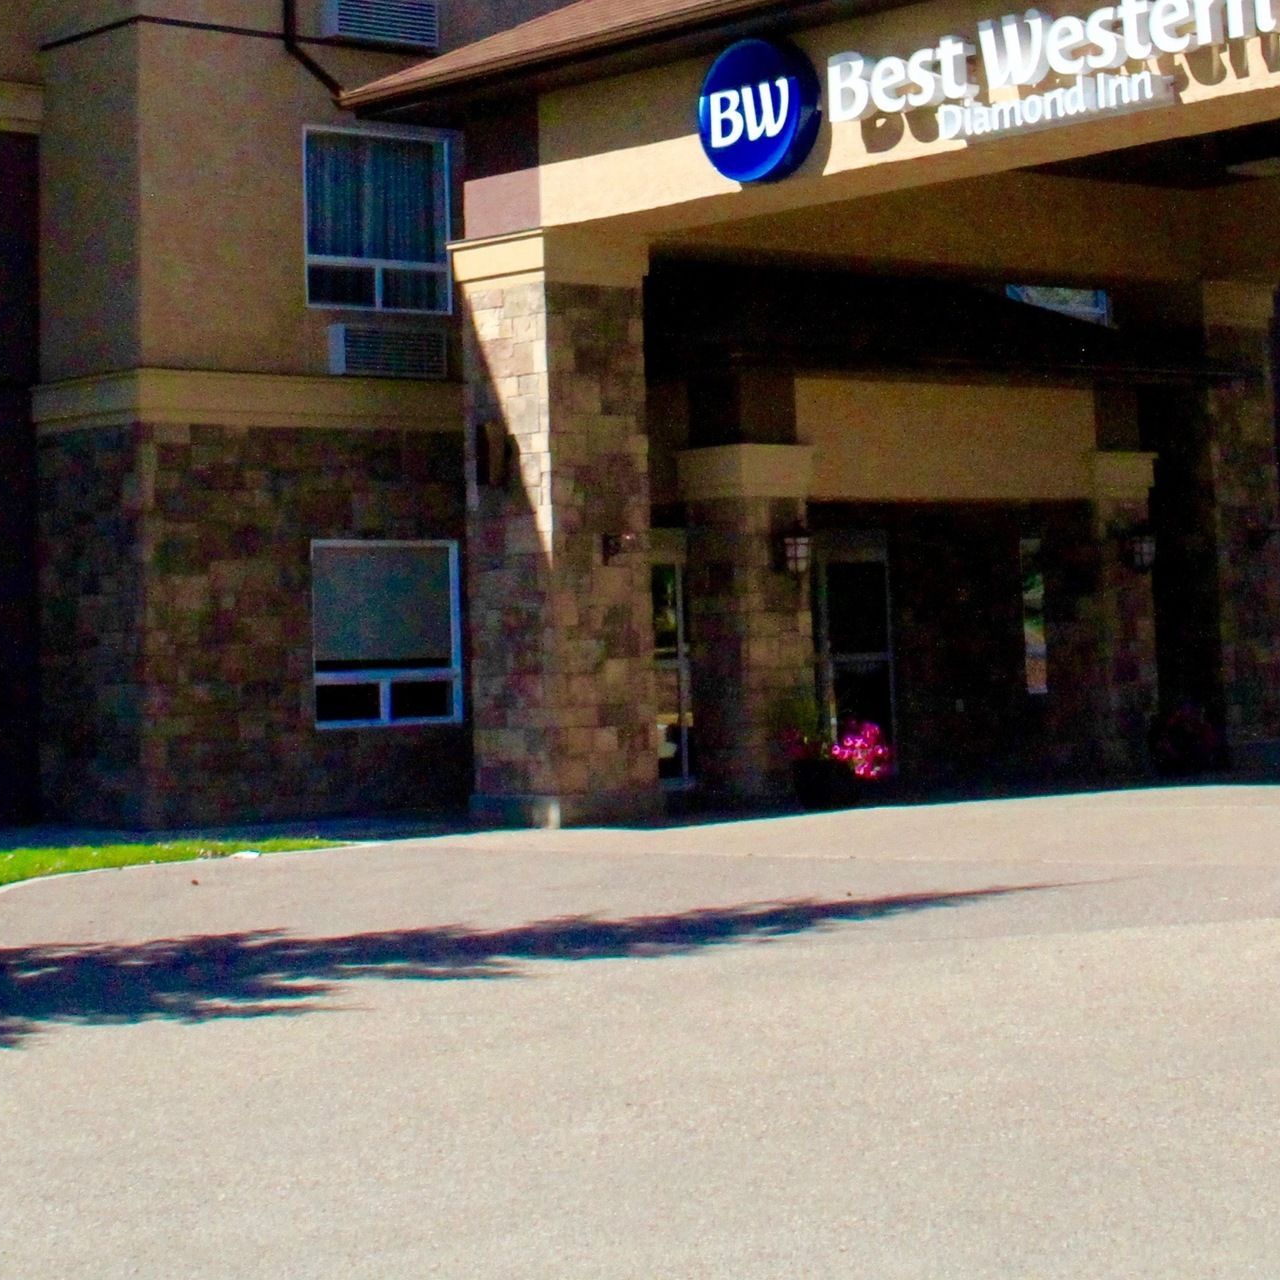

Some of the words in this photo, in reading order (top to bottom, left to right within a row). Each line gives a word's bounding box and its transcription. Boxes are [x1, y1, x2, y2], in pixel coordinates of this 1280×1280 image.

[710, 77, 790, 148] BW
[827, 35, 974, 123] Best
[936, 74, 1087, 140] Diamond
[1096, 68, 1156, 108] Inn
